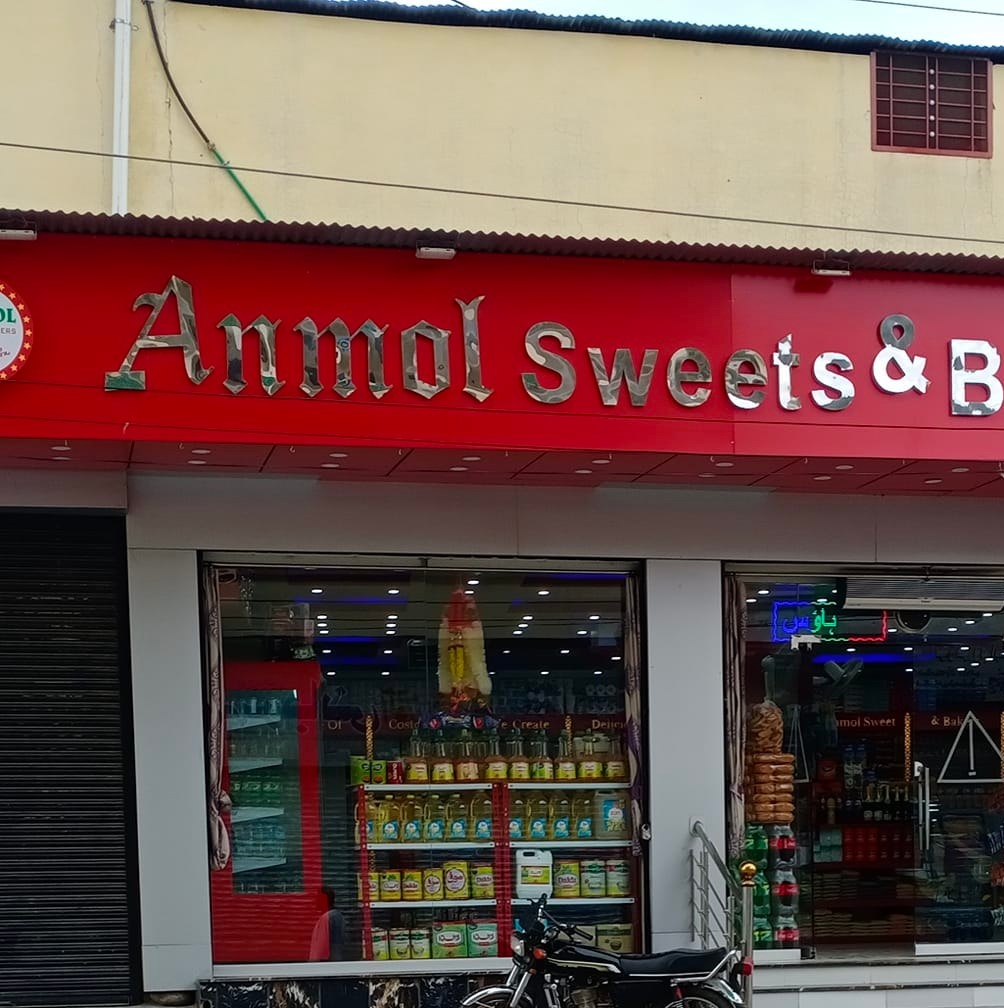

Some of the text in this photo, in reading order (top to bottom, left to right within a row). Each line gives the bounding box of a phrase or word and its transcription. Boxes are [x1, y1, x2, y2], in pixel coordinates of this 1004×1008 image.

[104, 275, 494, 402] Anmol
[520, 321, 855, 411] Sweets
[872, 313, 931, 394] &
[863, 715, 896, 727] Sweet
[931, 714, 940, 726] &
